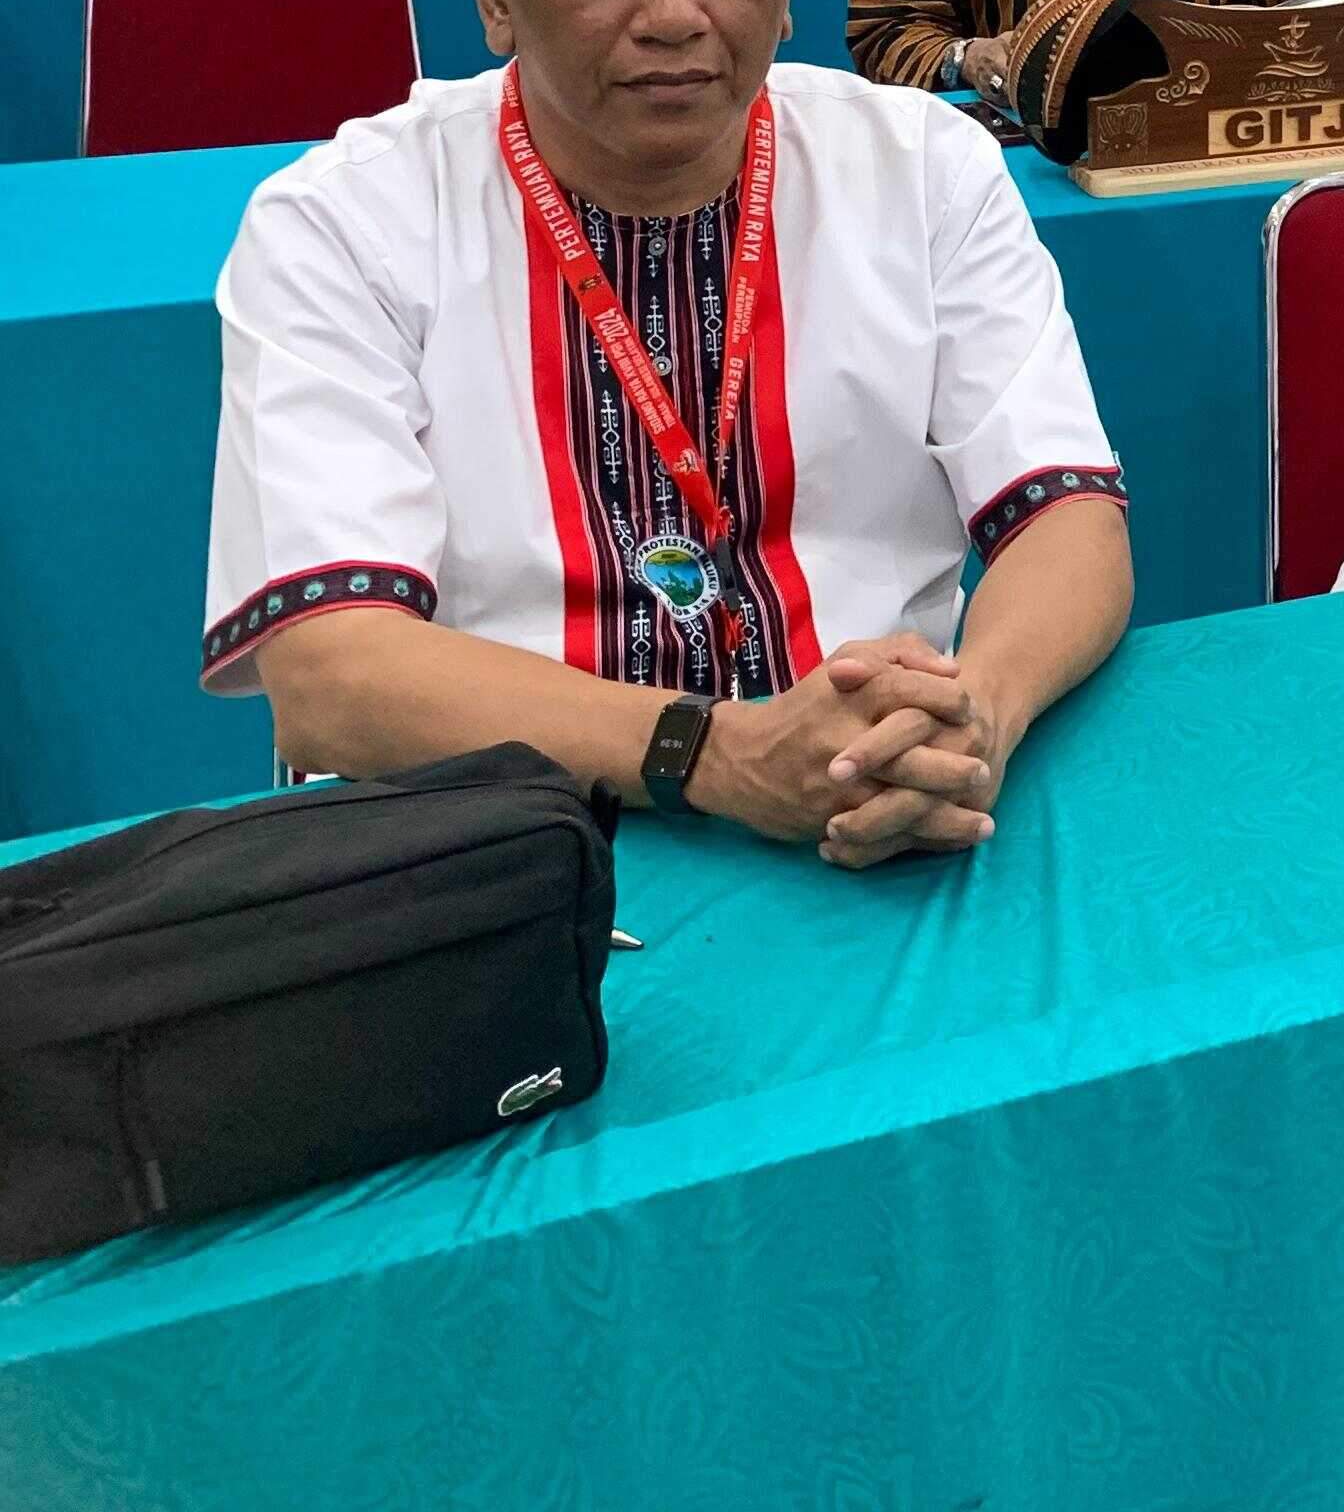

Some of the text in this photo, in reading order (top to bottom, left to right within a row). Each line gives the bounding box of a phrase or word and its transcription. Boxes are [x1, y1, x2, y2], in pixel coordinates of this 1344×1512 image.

[504, 120, 587, 263] PERTEMUAN RAYA
[740, 116, 772, 263] PERTEMUAN RAYA
[594, 307, 630, 344] 2024
[723, 356, 744, 422] GEREJA
[639, 538, 701, 557] PROTESTAN
